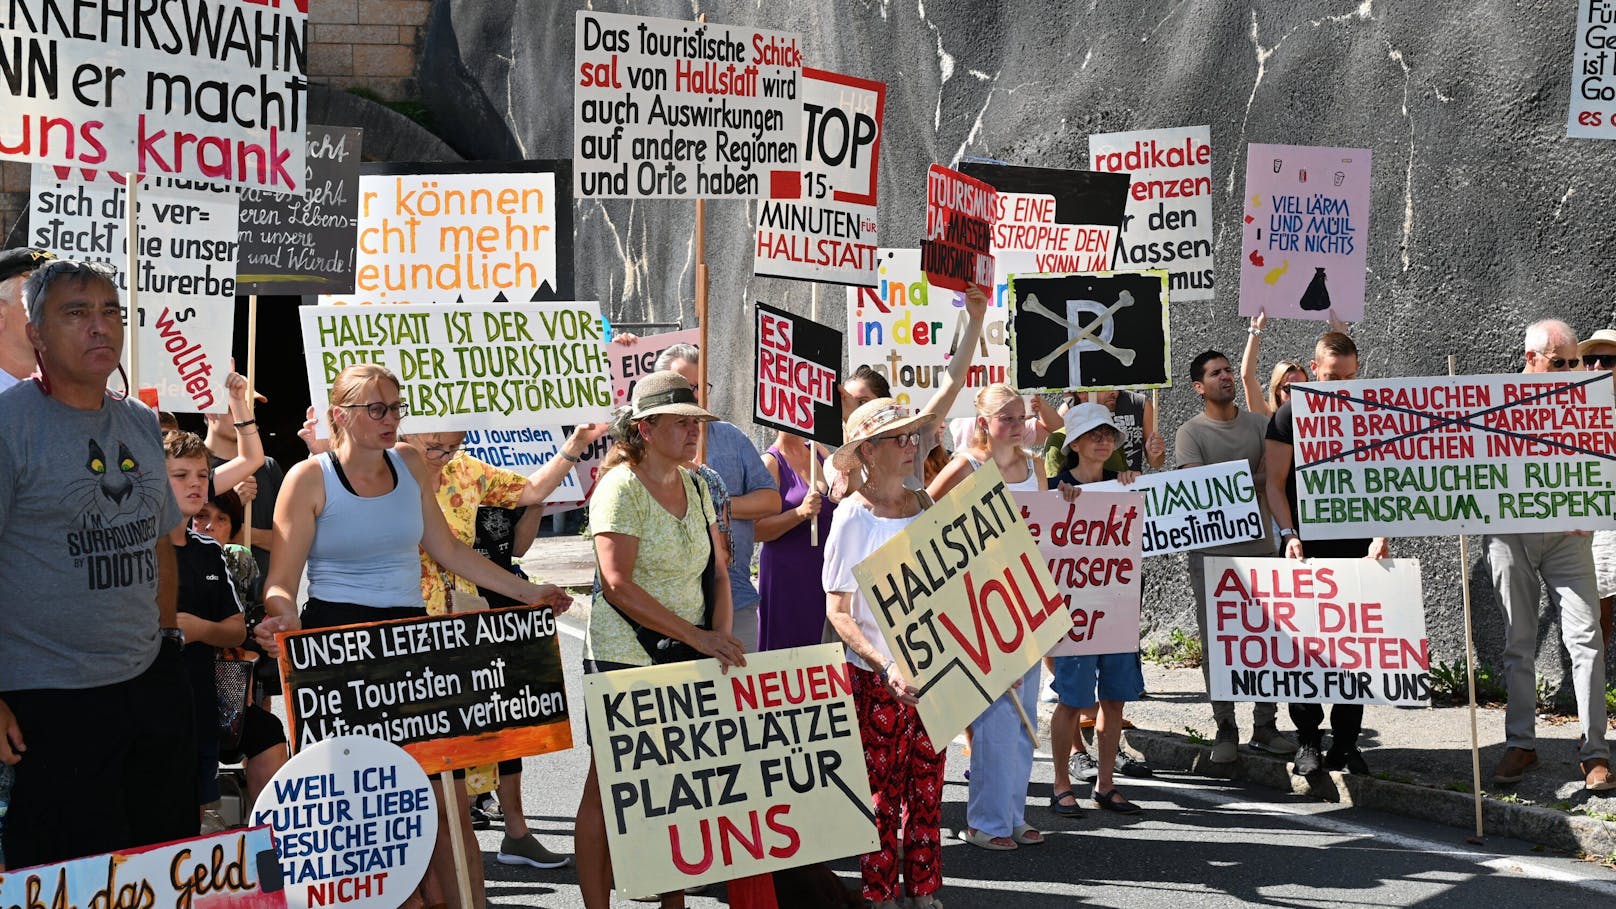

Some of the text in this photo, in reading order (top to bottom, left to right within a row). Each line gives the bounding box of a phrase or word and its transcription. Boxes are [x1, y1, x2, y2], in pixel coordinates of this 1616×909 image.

[0, 0, 308, 75] RKEHRSWAHN
[584, 17, 630, 53] Das
[752, 33, 802, 67] Schick-
[580, 55, 796, 100] sal von Hallstatt wird
[1583, 51, 1608, 75] ist
[72, 63, 125, 108] er
[145, 71, 307, 133] macht
[581, 93, 783, 141] auch Auswirkungen
[1578, 111, 1602, 126] es
[0, 114, 296, 191] uns krank
[581, 126, 797, 171] auf andere Regionen
[1095, 137, 1210, 173] radikale
[396, 177, 544, 217] können
[581, 161, 758, 196] und Orte haben
[929, 170, 997, 226] TOURISMUS
[1129, 177, 1211, 201] enzen
[37, 184, 92, 217] sich
[1014, 197, 1055, 223] EINE
[1148, 202, 1196, 231] den
[1272, 193, 1350, 217] VIEL LÄRM
[440, 216, 550, 252] mehr
[759, 201, 877, 240] MINUTEN FÜR
[1270, 214, 1355, 235] UND MÜLL
[34, 219, 118, 254] steckt
[171, 237, 239, 262] unser
[757, 230, 877, 271] HALLSTATT
[1075, 228, 1110, 253] DEN
[1269, 233, 1355, 256] FÜR NICHTS
[357, 252, 537, 291] eundlich
[317, 312, 430, 347] HALLSTATT
[443, 311, 472, 345] IST
[483, 311, 535, 342] DER
[761, 315, 791, 353] ES
[856, 310, 883, 345] in
[892, 310, 943, 345] der
[155, 307, 215, 411] wollten
[399, 347, 450, 381] DER
[760, 350, 835, 401] REICHT
[759, 383, 814, 429] UNS
[1304, 381, 1586, 414] WIR BRAUCHEN BETTEN
[1296, 404, 1614, 438] WIR BRAUCHEN PARKPLÄTZE
[1299, 431, 1616, 464] WIR BRAUCHEN INVESTOREN
[1301, 468, 1356, 495] WIR
[1365, 463, 1508, 494] BRAUCHEN
[82, 511, 103, 529] I'M
[1050, 503, 1138, 547] denkt
[1300, 494, 1491, 524] LEBENSRAUM,
[74, 558, 85, 568] BY
[872, 481, 1017, 628] HALLSTATT
[1214, 568, 1339, 599] ALLES
[937, 552, 1065, 676] VOLL
[1217, 598, 1384, 634] FÜR DIE
[289, 608, 556, 669] UNSER LETZTER AUSWEG
[896, 608, 945, 678] IST
[1217, 634, 1429, 670] TOURISTEN
[298, 657, 506, 719] Die Touristen mit
[603, 662, 854, 731] KEINE NEUEN
[1231, 669, 1432, 701] NICHTS FÜR UNS
[459, 685, 564, 731] vertreiben
[610, 701, 852, 773] PARKPLÄTZE
[274, 765, 397, 804] WEIL ICH
[610, 747, 858, 835] PLATZ FÜR
[255, 787, 429, 832] KULTUR LIEBE
[385, 815, 422, 842] ICH
[668, 804, 801, 876] UNS
[170, 834, 256, 909] Geld
[280, 843, 409, 885] HALLSTATT
[307, 872, 388, 909] NICHT
